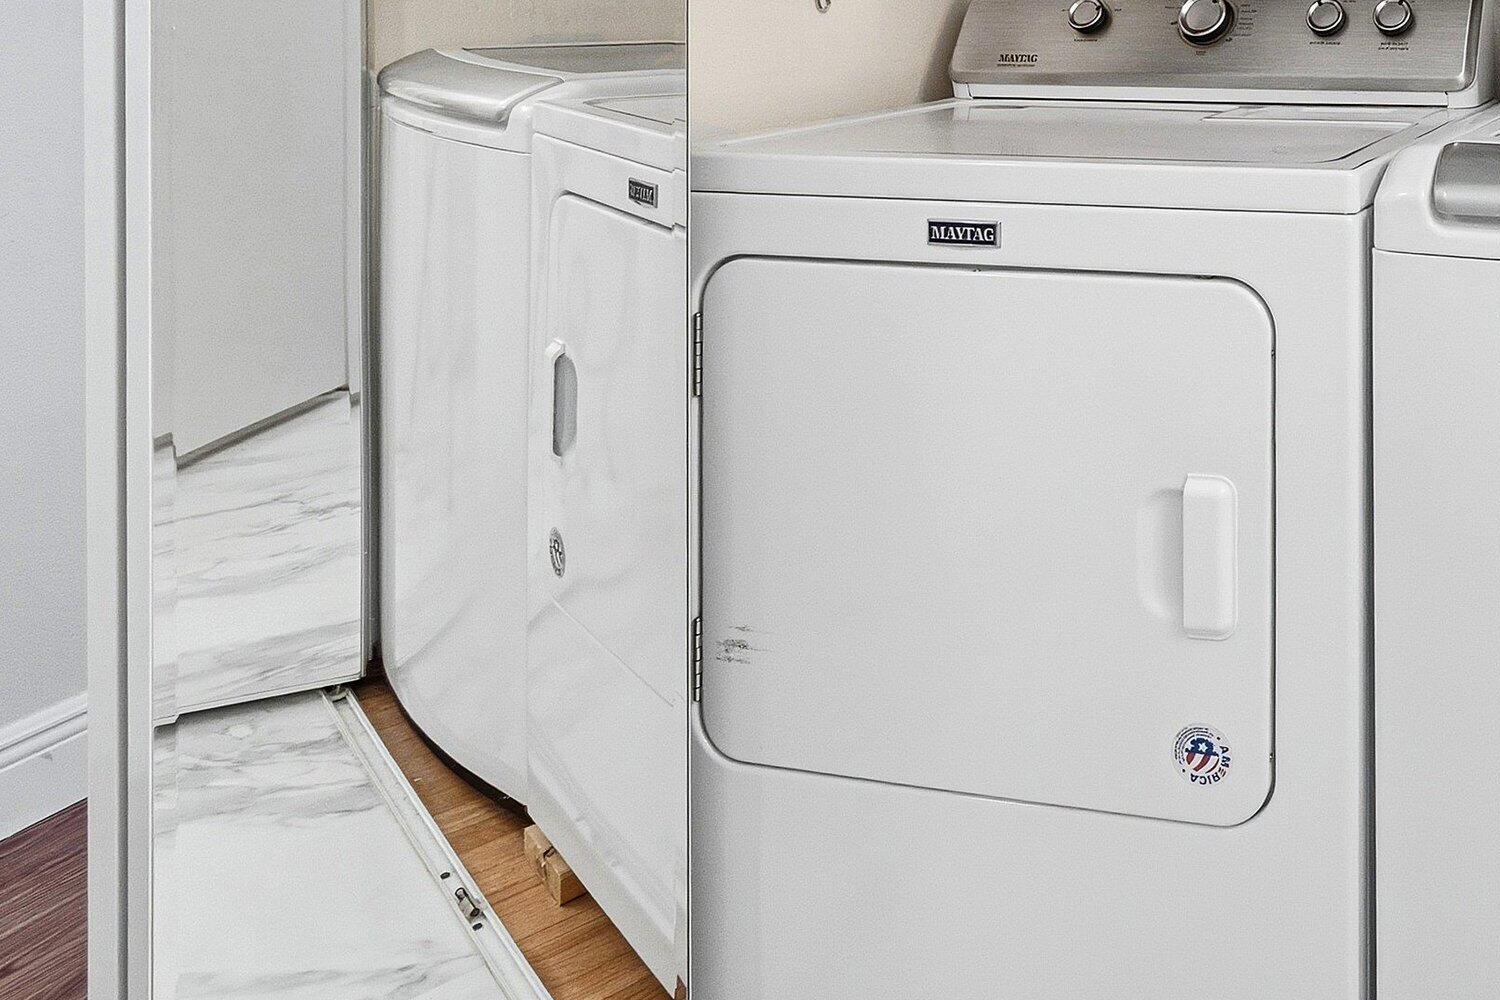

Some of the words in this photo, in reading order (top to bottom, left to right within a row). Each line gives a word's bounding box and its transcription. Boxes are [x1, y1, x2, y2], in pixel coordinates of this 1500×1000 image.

[998, 53, 1039, 62] MAYTAG
[930, 225, 995, 242] MAYTAG
[1190, 745, 1231, 785] AMERICA
